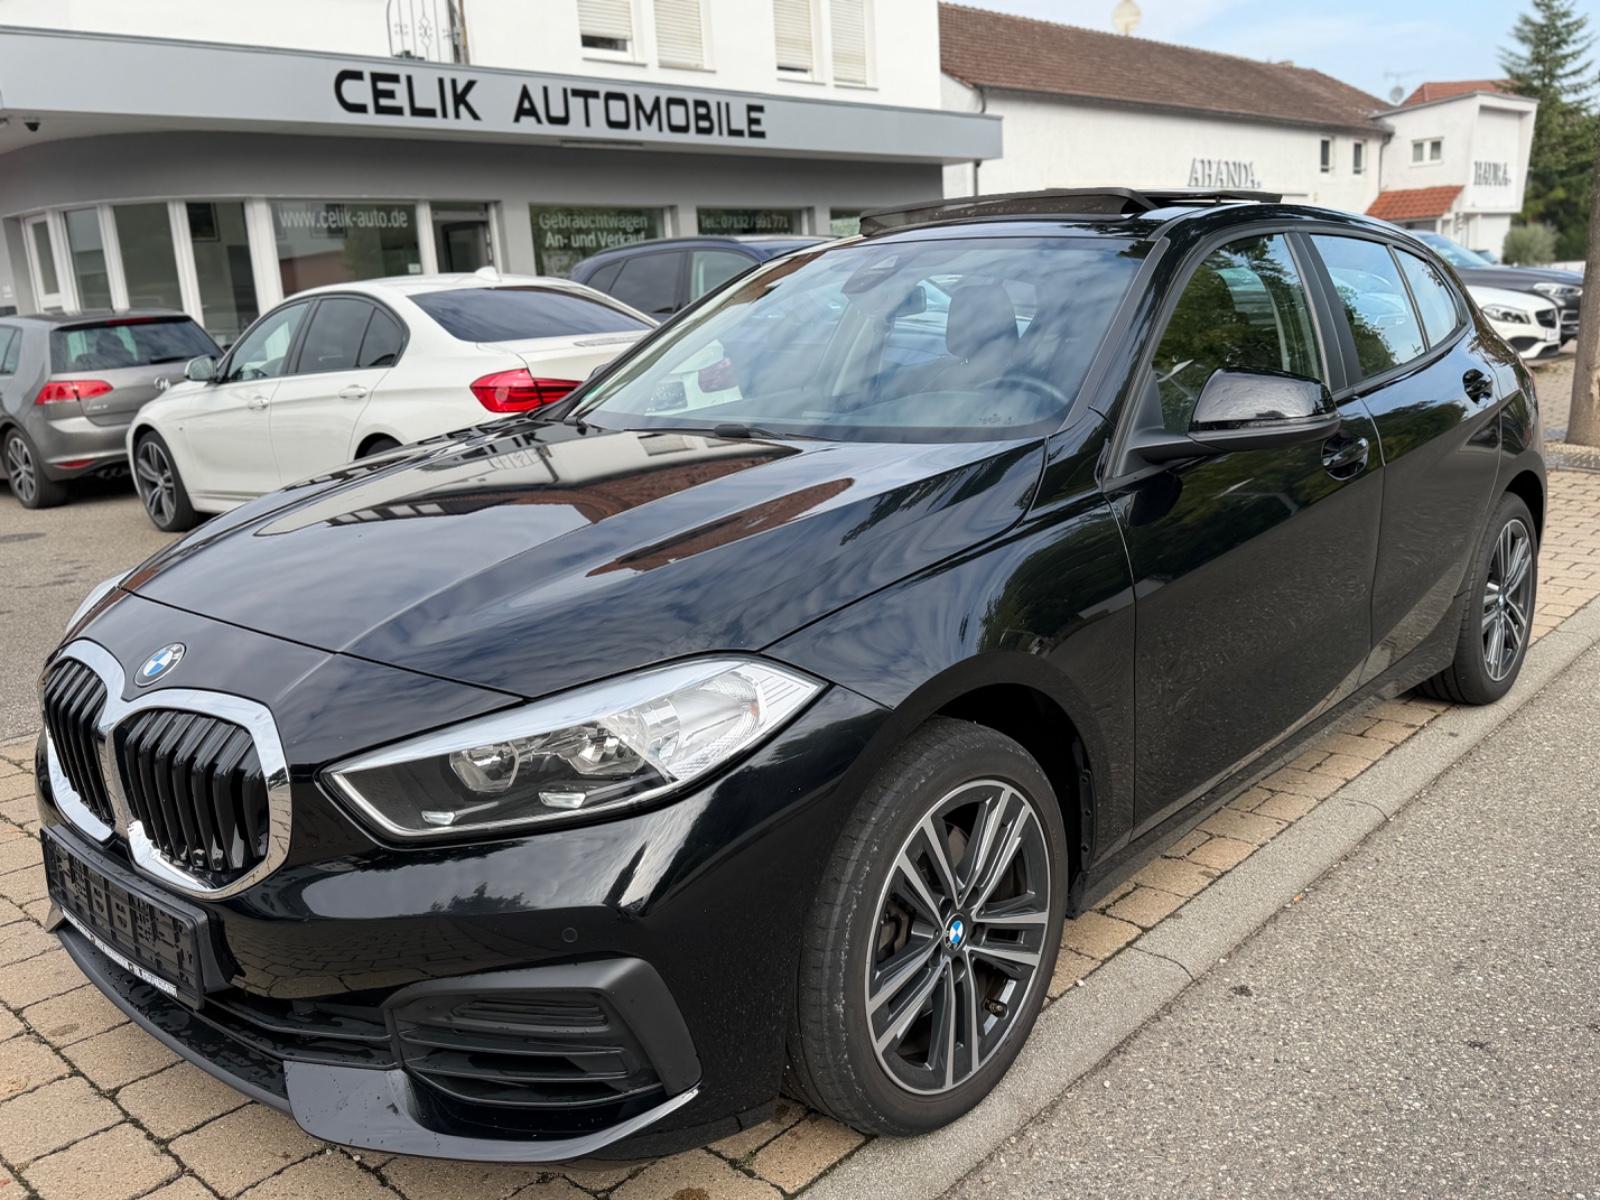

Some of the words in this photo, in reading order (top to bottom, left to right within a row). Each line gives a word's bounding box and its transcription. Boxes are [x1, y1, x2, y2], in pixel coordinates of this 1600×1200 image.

[334, 69, 482, 121] CELIK
[513, 84, 767, 139] AUTOMOBILE
[279, 206, 409, 228] www.celik-auto.de
[540, 213, 648, 232] Gebrauchtwagen
[545, 231, 569, 248] An-
[571, 231, 596, 248] und
